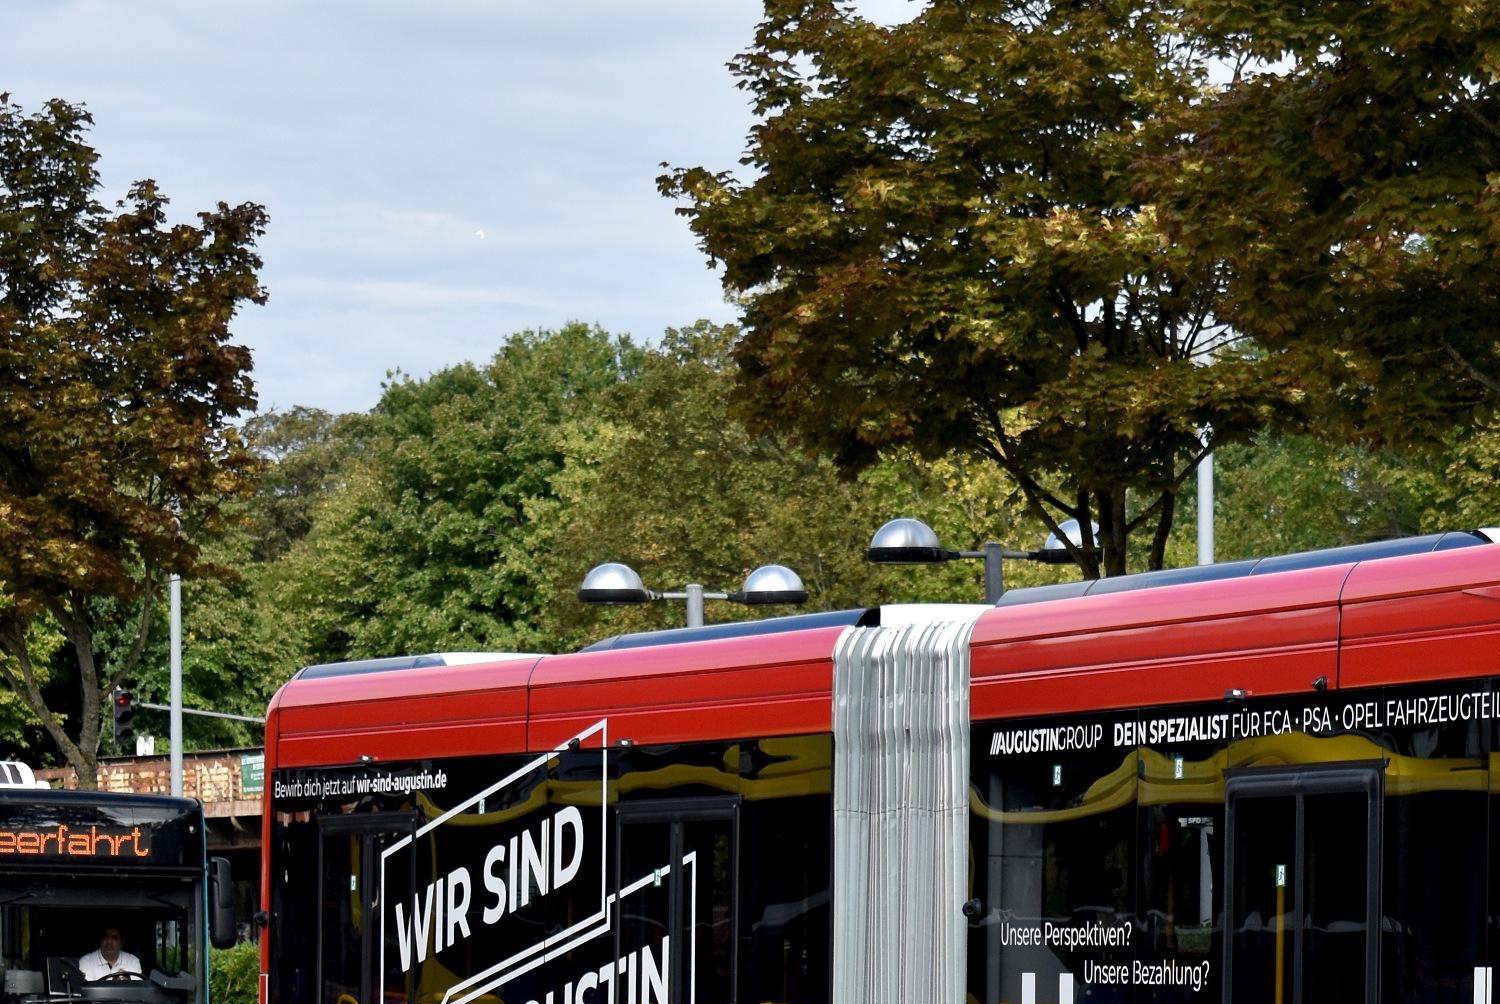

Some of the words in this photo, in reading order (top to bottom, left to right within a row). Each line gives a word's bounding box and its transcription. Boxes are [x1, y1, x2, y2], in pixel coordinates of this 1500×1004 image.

[1114, 721, 1146, 746] DEIN
[1150, 714, 1229, 744] SPEZIALIST
[1232, 708, 1260, 738] FÜR
[1264, 710, 1292, 736] FCA
[1303, 706, 1332, 733] PSA
[1342, 702, 1382, 730] OPEL
[274, 780, 302, 798] Bewirb
[304, 778, 320, 796] dich
[321, 778, 340, 800] jetzt
[341, 776, 356, 794] auf
[356, 770, 447, 794] wir-sind-augustin.de
[395, 866, 472, 973] WIR
[482, 805, 584, 925] SIND
[1000, 922, 1041, 946] Unsere
[1044, 921, 1132, 952] Perspektiven?
[1084, 960, 1129, 984] Unsere
[1132, 958, 1210, 992] Bezahlung?
